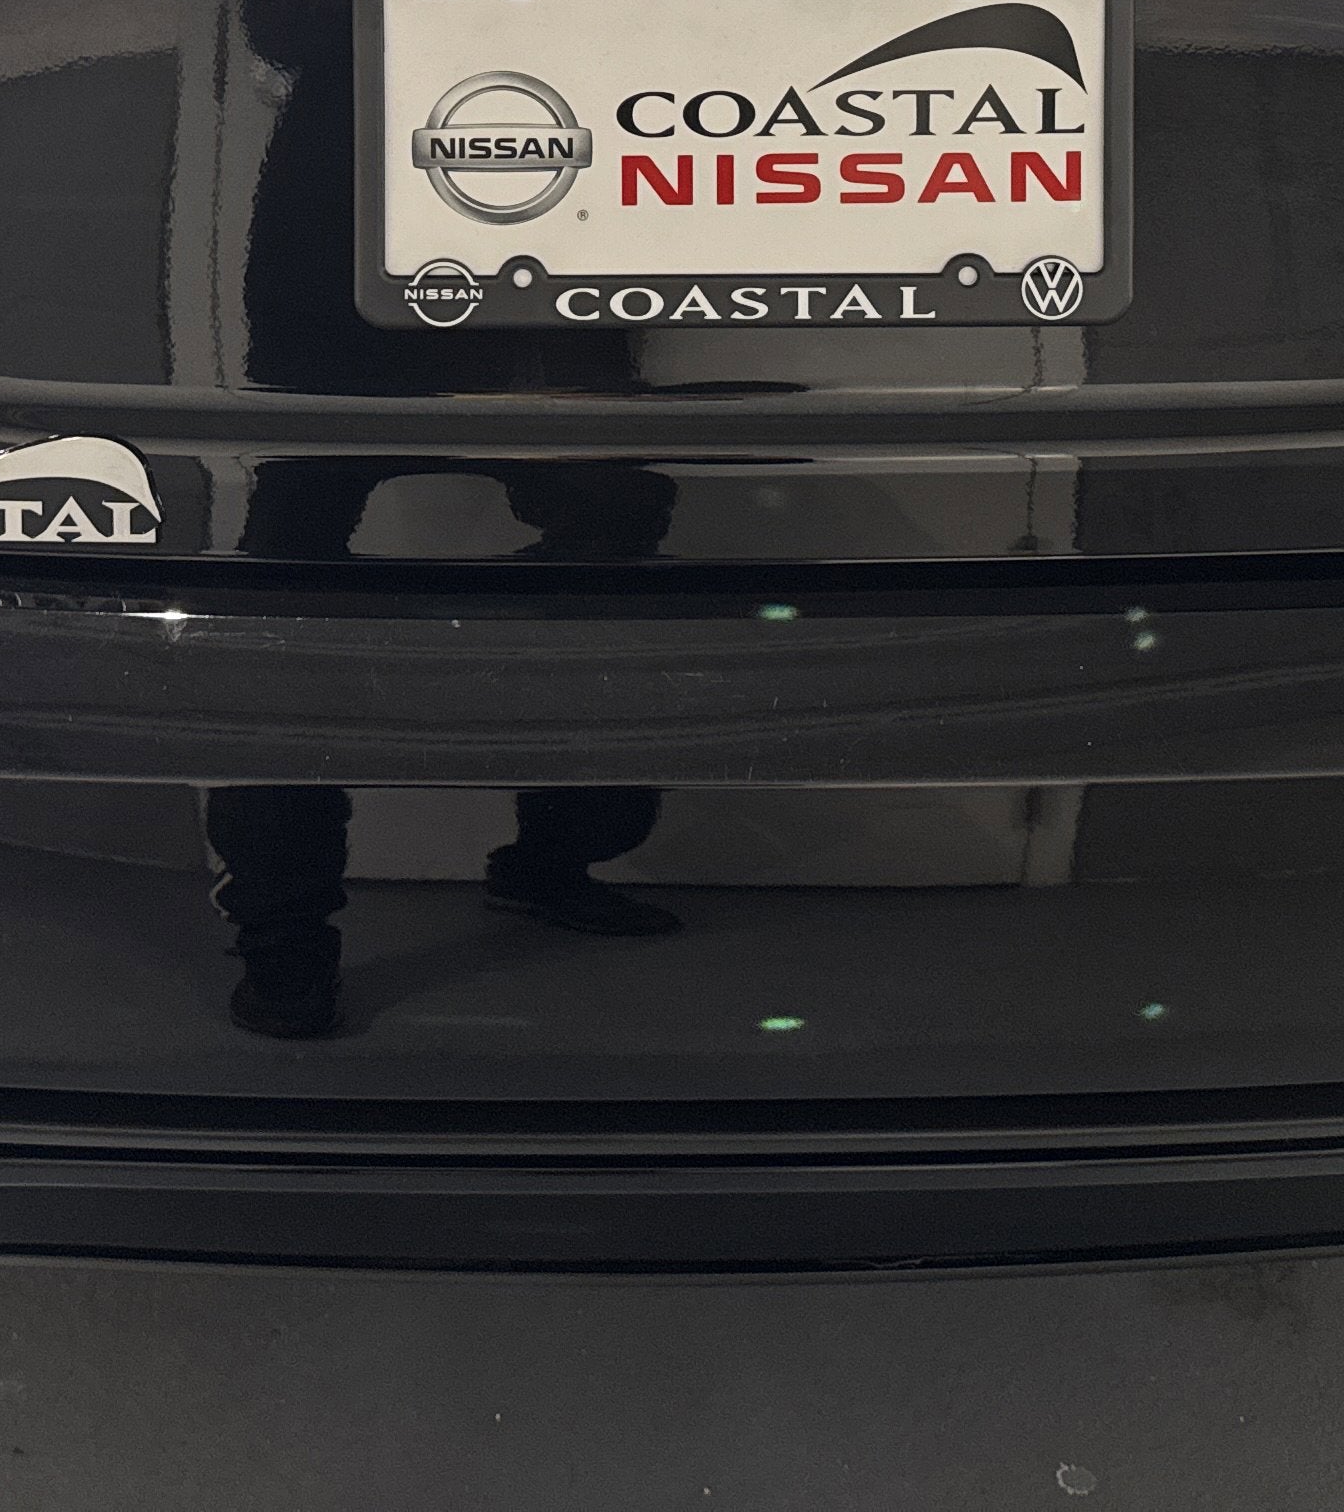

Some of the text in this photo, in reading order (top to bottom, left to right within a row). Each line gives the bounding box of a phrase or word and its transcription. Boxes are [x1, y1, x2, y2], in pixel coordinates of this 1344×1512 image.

[616, 84, 1086, 138] COASTAL
[430, 137, 574, 159] NISSAN
[621, 151, 1082, 206] NISSAN
[404, 288, 483, 300] NISSAN
[555, 284, 936, 321] COASTAL
